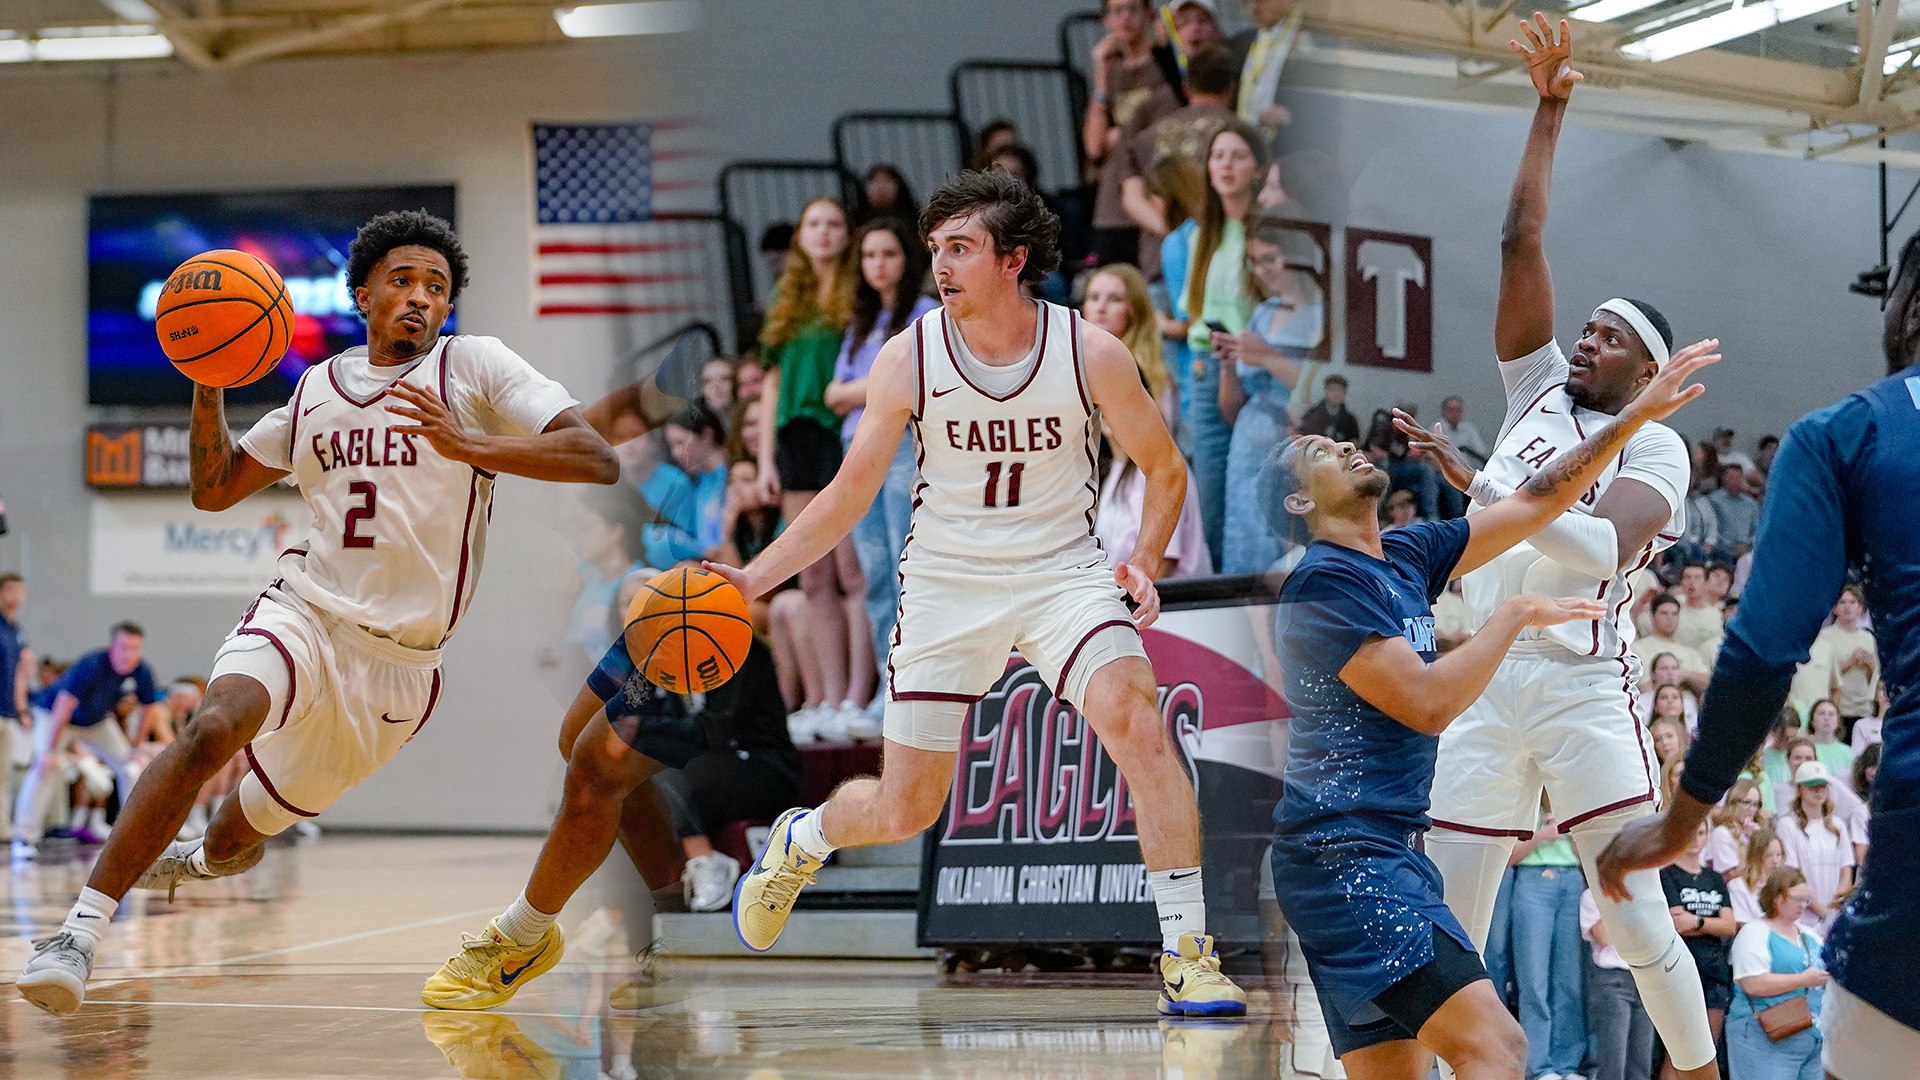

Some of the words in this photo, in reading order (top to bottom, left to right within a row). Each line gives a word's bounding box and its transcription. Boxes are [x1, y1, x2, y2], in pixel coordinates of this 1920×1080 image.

[312, 427, 417, 472] EAGLES
[946, 416, 1062, 452] EAGLES
[983, 461, 1027, 508] 11
[342, 481, 376, 550] 2
[164, 521, 260, 560] Mercy
[936, 866, 1015, 906] OKLAHOMA
[1017, 864, 1098, 905] CHRISTIAN
[1099, 863, 1155, 904] UNIVER
